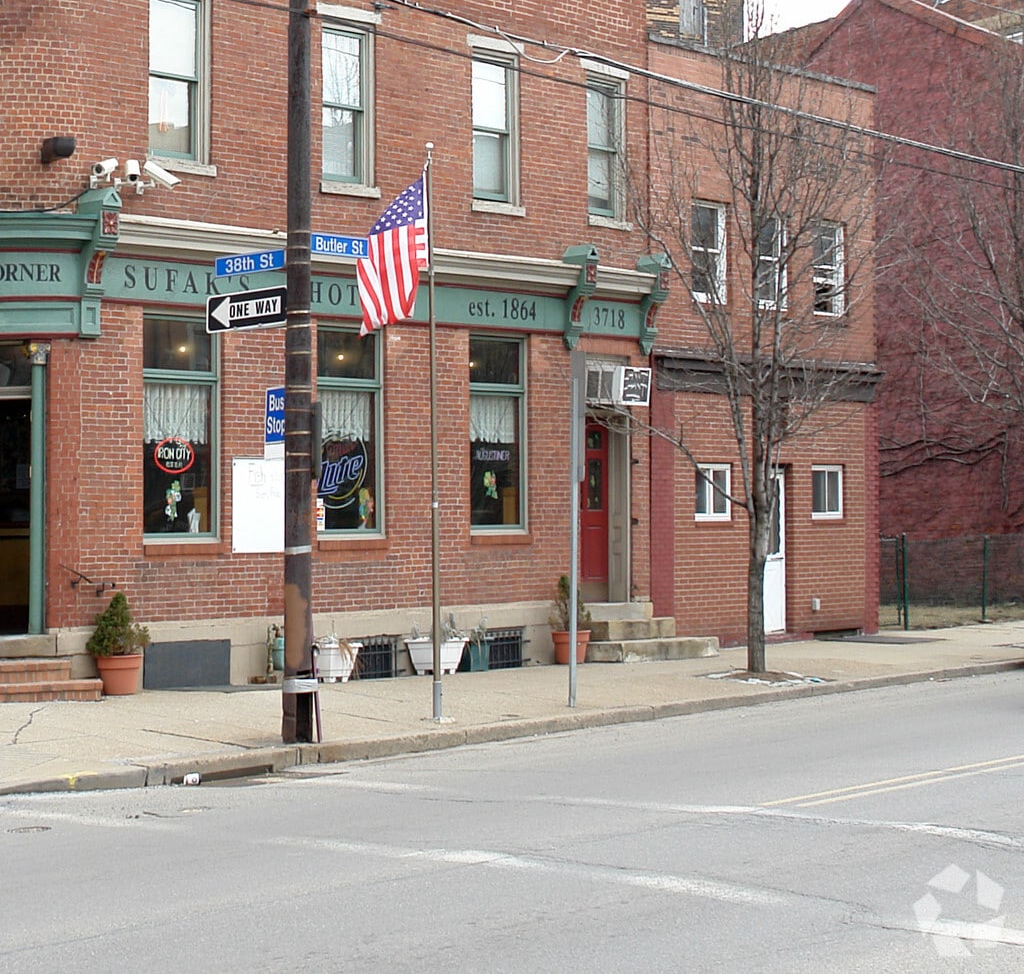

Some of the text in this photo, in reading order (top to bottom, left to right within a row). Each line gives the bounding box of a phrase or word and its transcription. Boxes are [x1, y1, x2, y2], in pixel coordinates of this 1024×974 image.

[315, 237, 364, 255] Butler St
[225, 253, 274, 274] 38th St
[124, 264, 536, 321] SUFAK'S HOT est. 1864
[229, 298, 278, 318] ONE WAY
[593, 307, 625, 330] 3718
[269, 394, 285, 412] Bus
[266, 416, 285, 436] Stop
[317, 455, 364, 496] Lite
